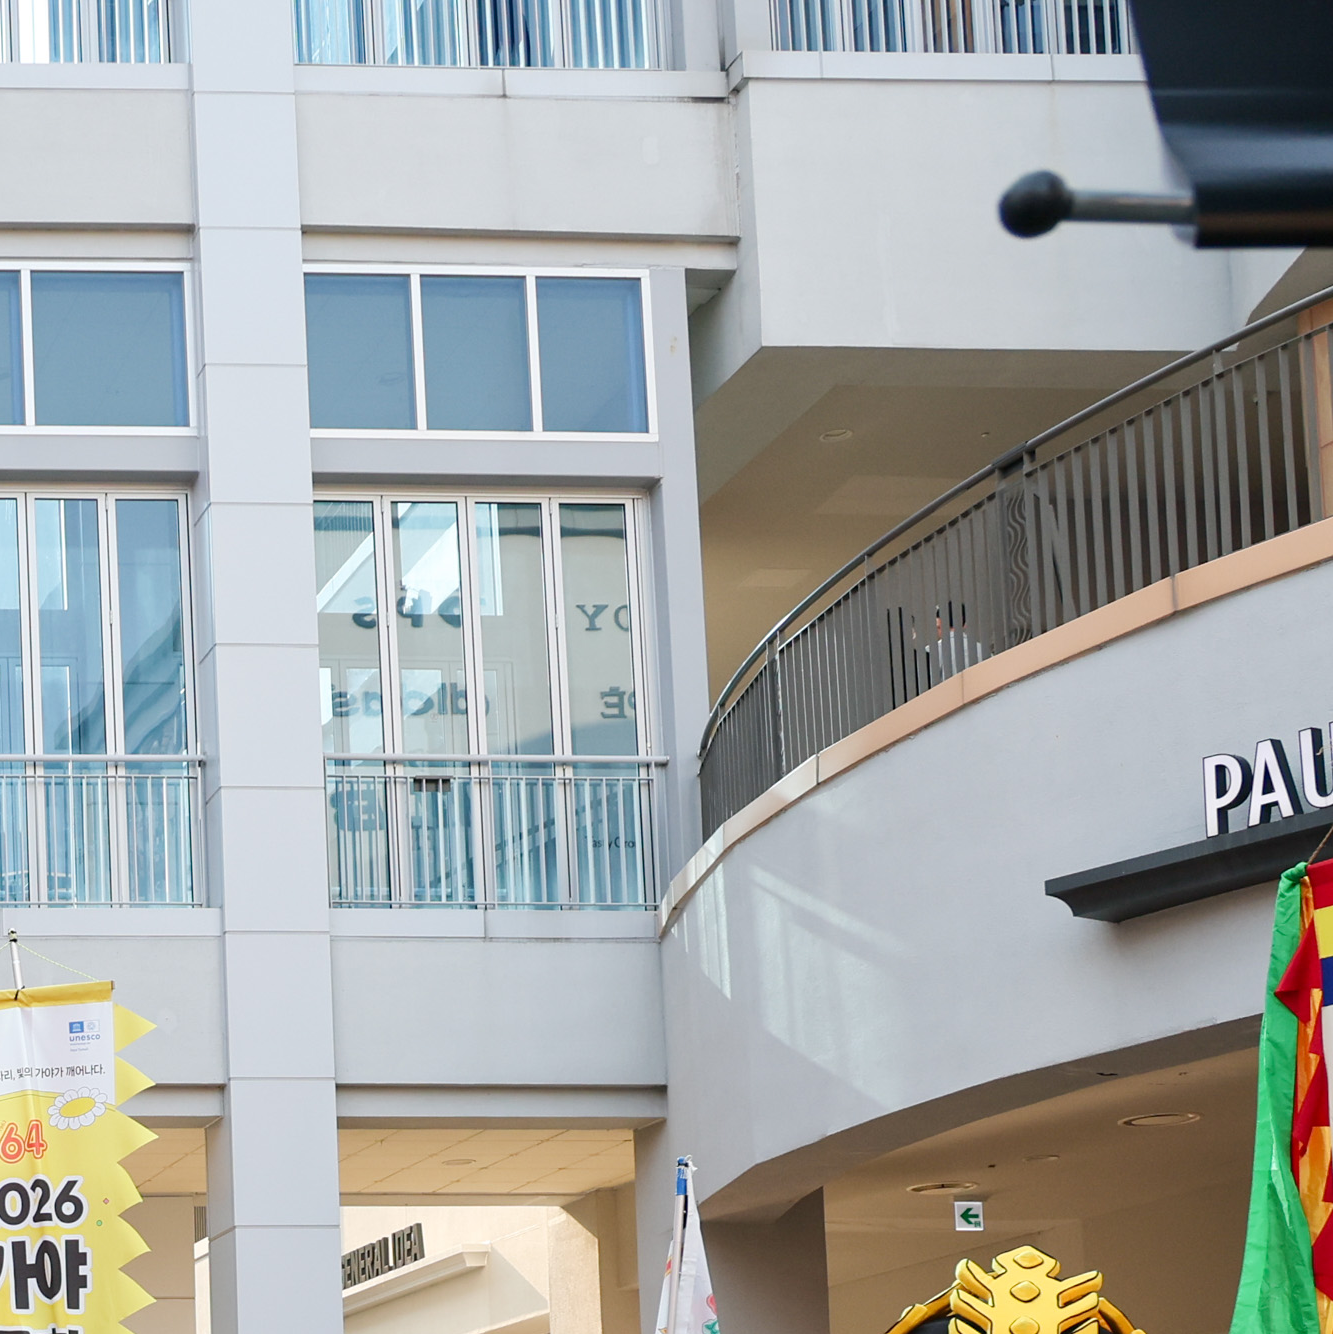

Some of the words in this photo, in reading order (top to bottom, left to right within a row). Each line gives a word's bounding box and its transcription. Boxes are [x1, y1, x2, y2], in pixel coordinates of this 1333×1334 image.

[69, 1033, 101, 1042] unesco
[35, 1066, 64, 1079] 가야가
[66, 1064, 106, 1077] 깨어나다.
[341, 1236, 389, 1291] ENERAL
[390, 1222, 425, 1271] IDEA
